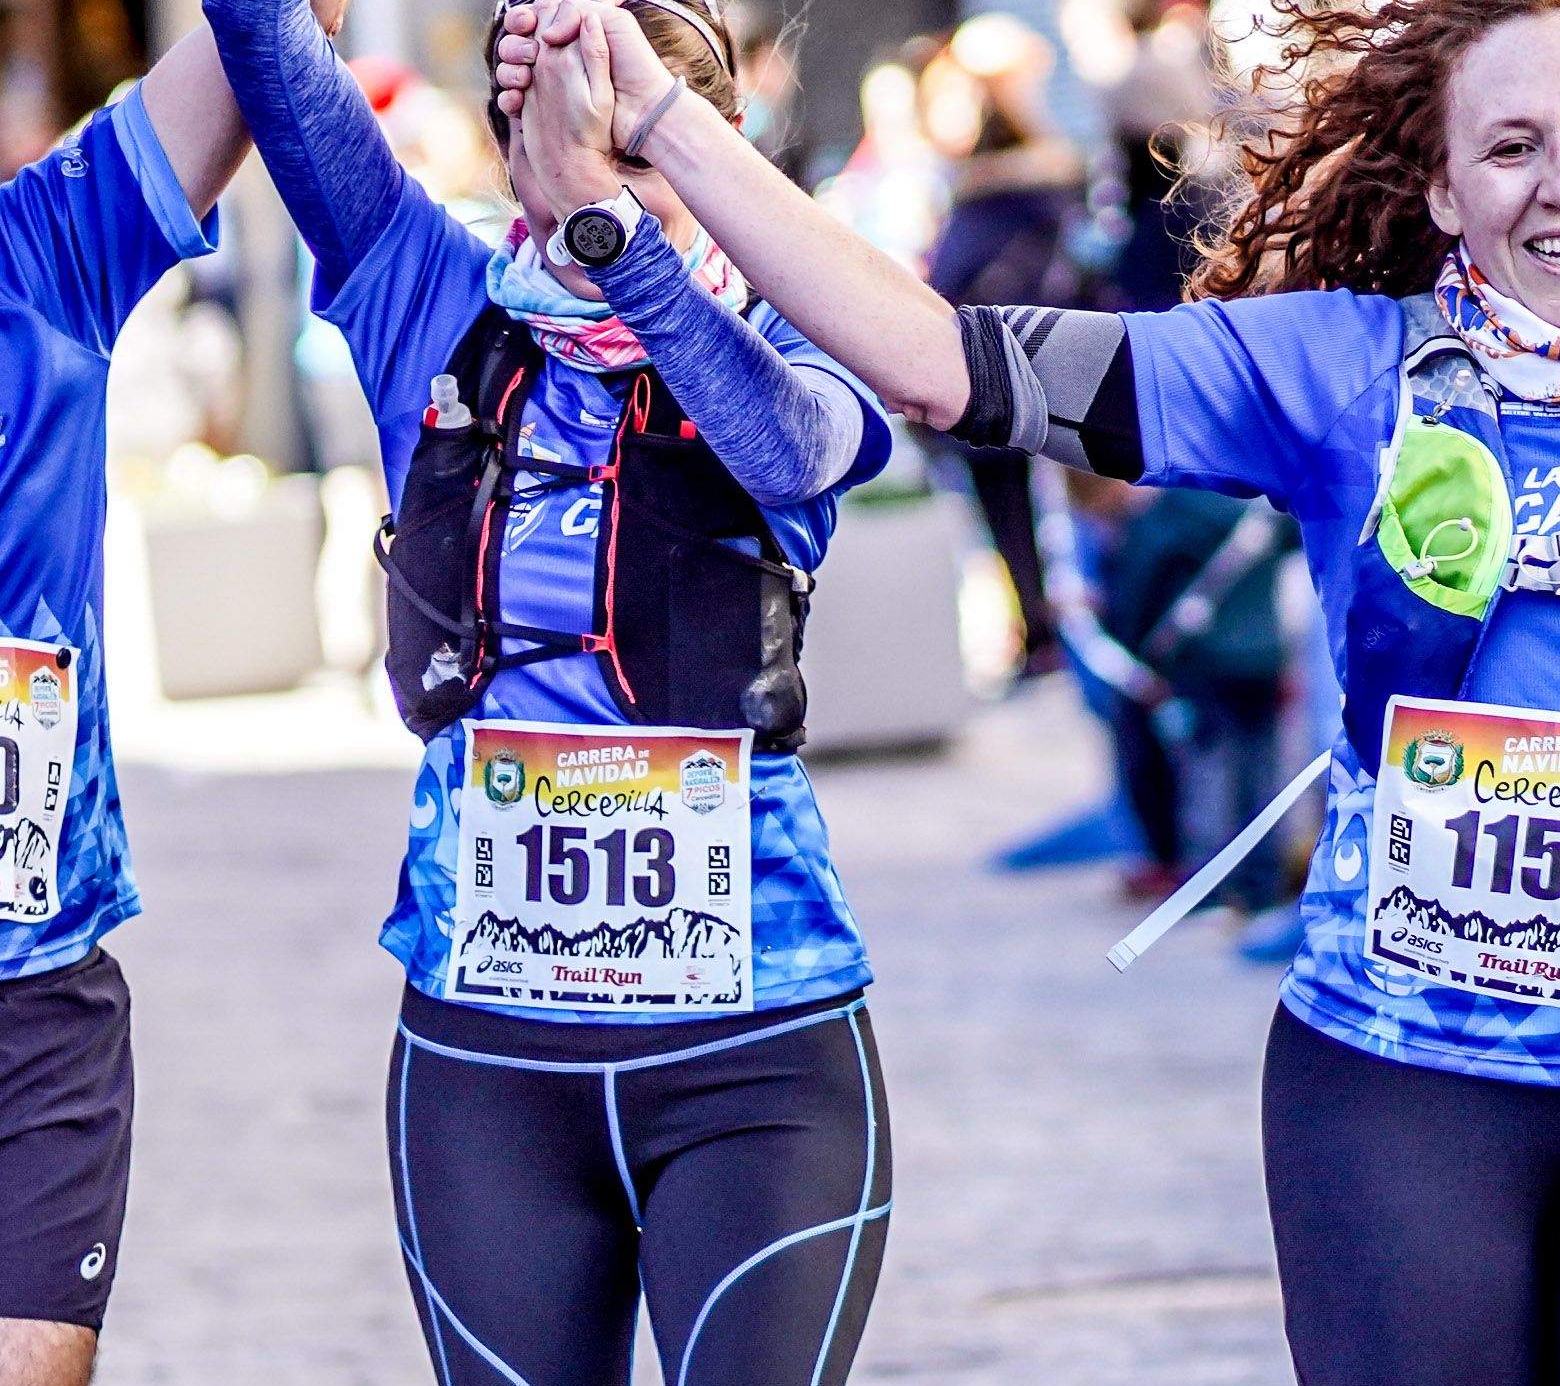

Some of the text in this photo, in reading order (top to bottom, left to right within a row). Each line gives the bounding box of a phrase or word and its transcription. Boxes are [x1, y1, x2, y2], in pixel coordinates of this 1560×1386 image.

[557, 745, 634, 768] CARRERA
[556, 760, 649, 788] NAVIDAD
[516, 824, 676, 907] 1513
[1408, 933, 1443, 954] asics
[494, 960, 523, 975] asics
[552, 965, 642, 985] Trail Run
[1477, 952, 1529, 976] Trail
